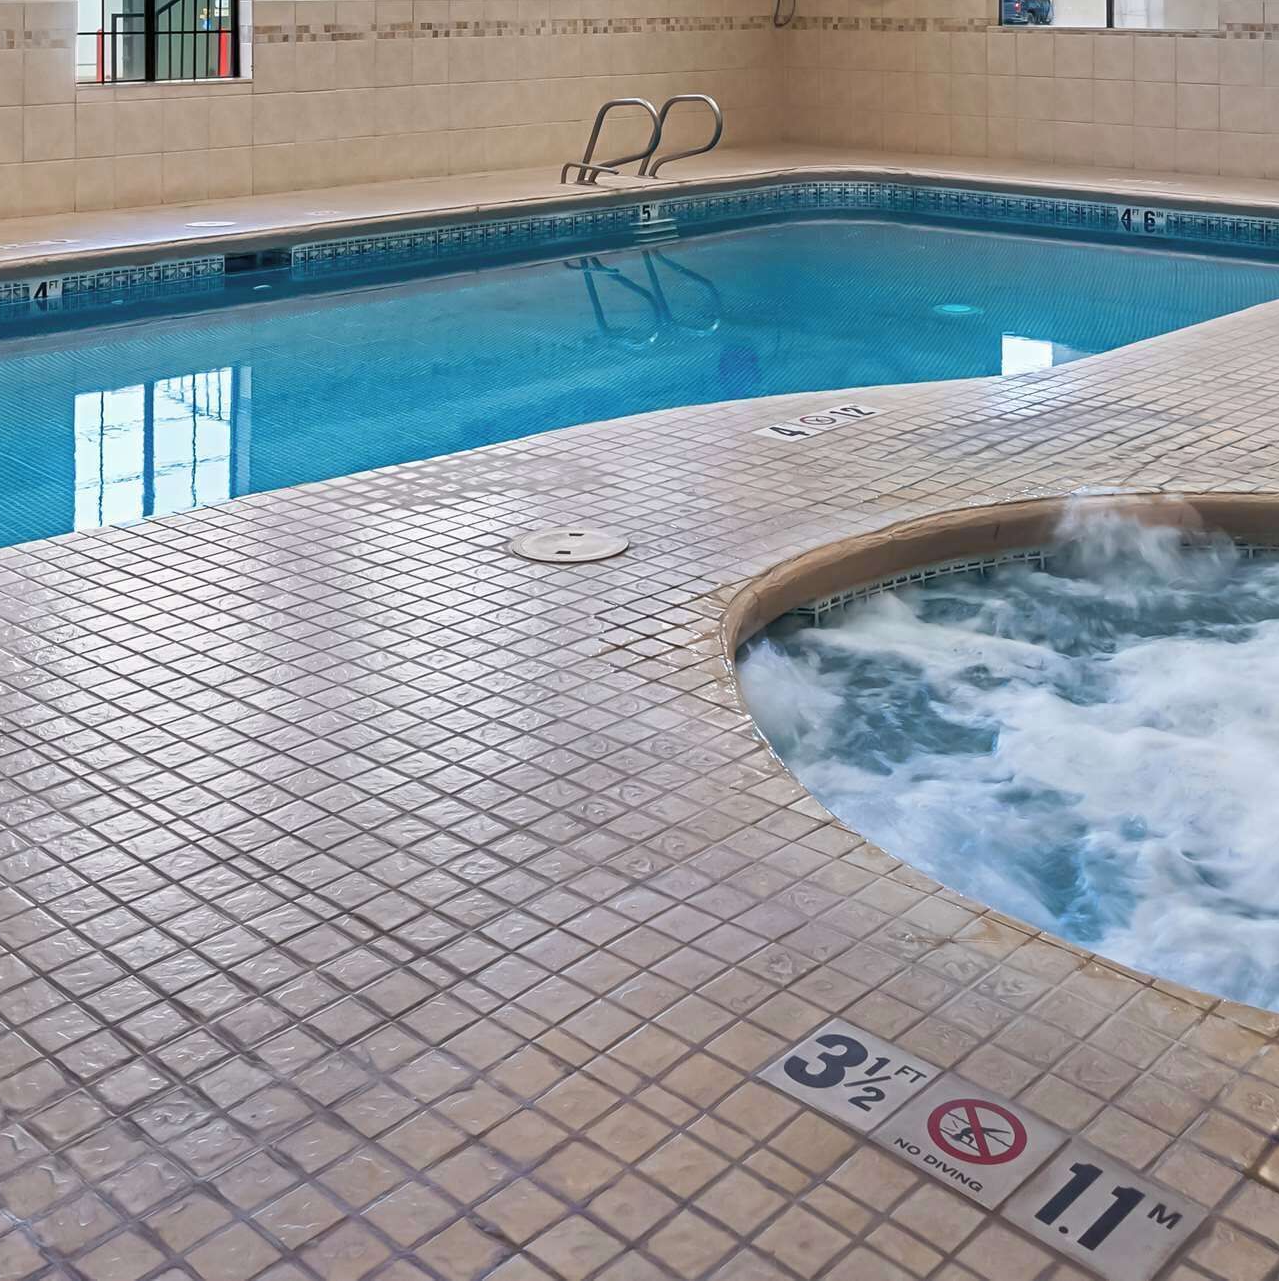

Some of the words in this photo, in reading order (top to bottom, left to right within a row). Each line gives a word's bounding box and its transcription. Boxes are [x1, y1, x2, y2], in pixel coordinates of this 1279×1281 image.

[1121, 208, 1132, 221] 4
[1144, 211, 1155, 224] 6
[34, 281, 48, 299] 4
[49, 280, 60, 290] FT
[894, 1065, 927, 1083] FT
[894, 1137, 921, 1155] NO
[923, 1154, 984, 1192] DIVING
[1034, 1162, 1146, 1251] 1.1
[1147, 1202, 1183, 1230] M
